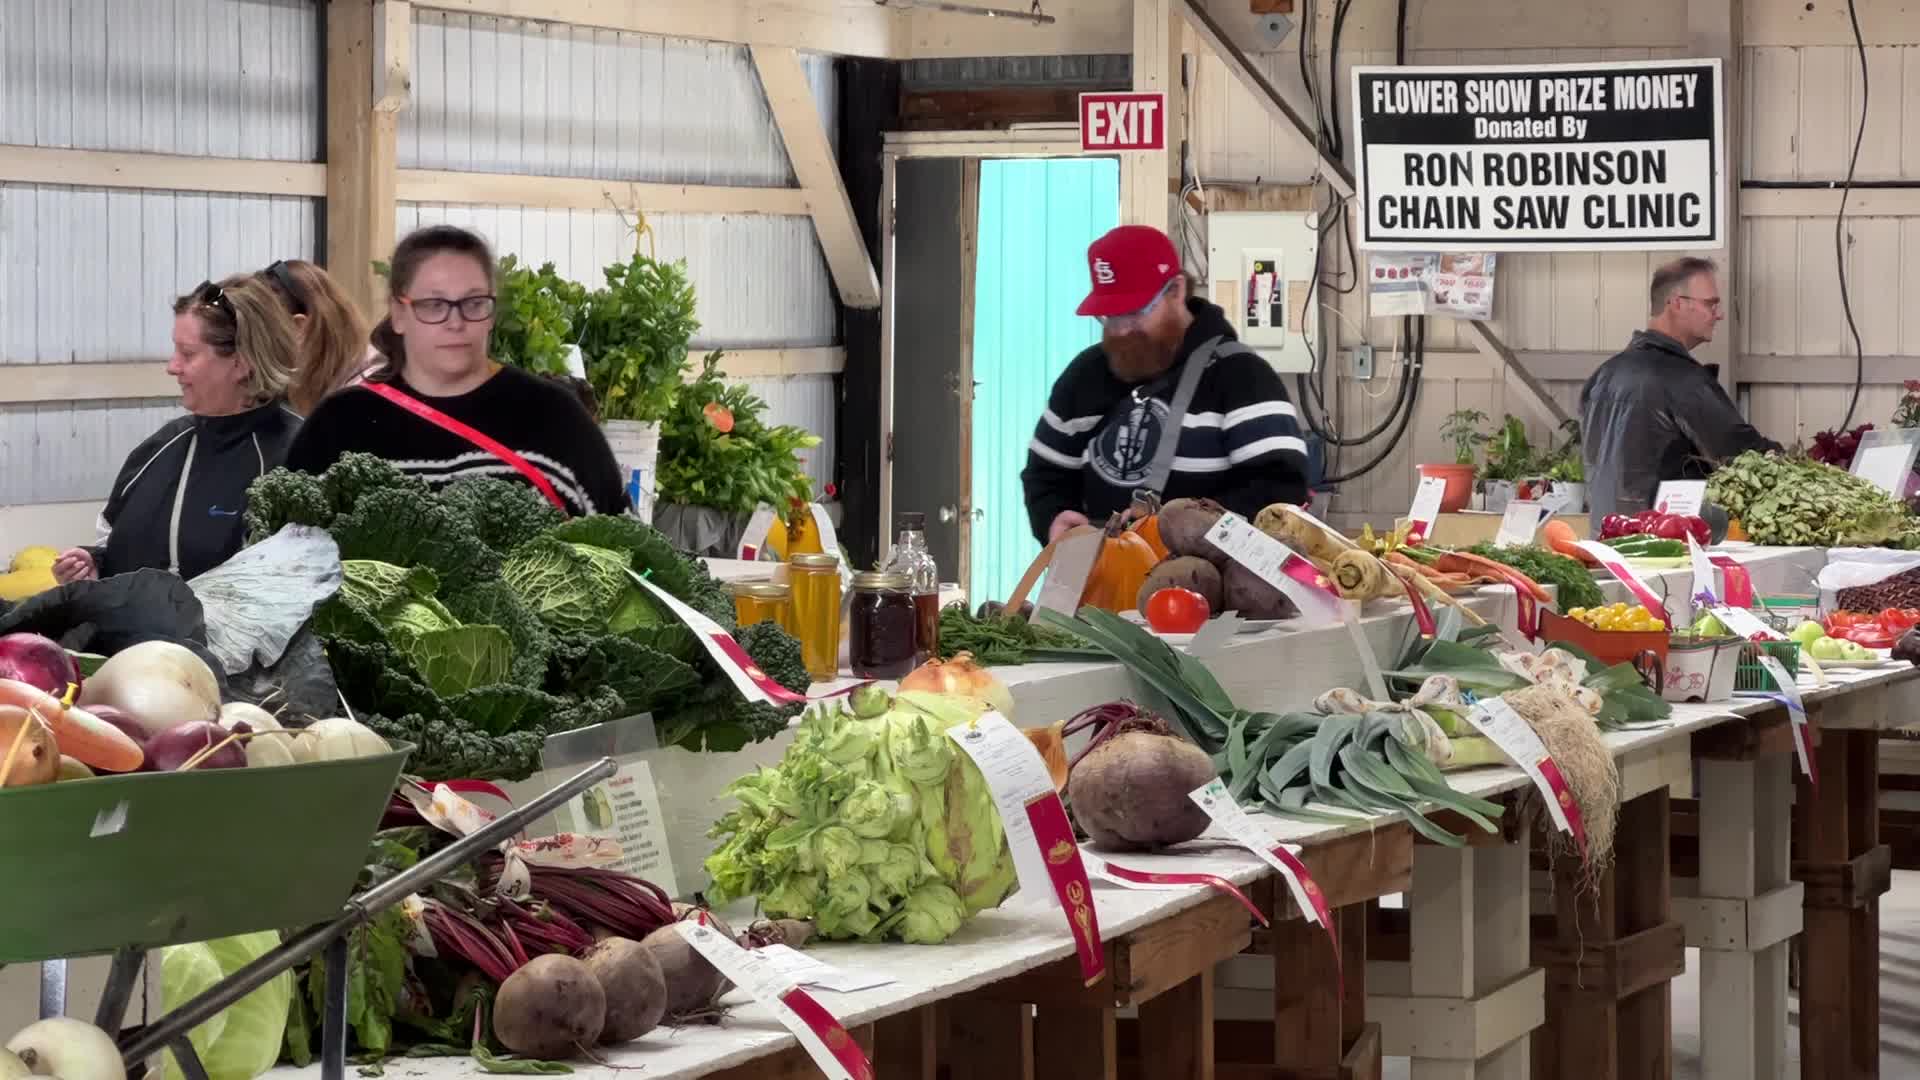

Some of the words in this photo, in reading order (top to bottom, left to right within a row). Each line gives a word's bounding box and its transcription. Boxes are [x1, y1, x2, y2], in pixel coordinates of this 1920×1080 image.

[1372, 79, 1459, 114] FLOWER
[1464, 79, 1533, 114] SHOW
[1539, 77, 1607, 112] PRIZE
[1613, 73, 1699, 110] MONEY
[1088, 101, 1158, 145] EXIT
[1474, 116, 1557, 139] Donated
[1562, 115, 1588, 140] By
[1403, 150, 1474, 188] RON
[1482, 149, 1667, 187] ROBINSON
[1378, 194, 1481, 230] CHAIN
[1493, 194, 1570, 230] SAW
[1583, 192, 1701, 230] CLINIC
